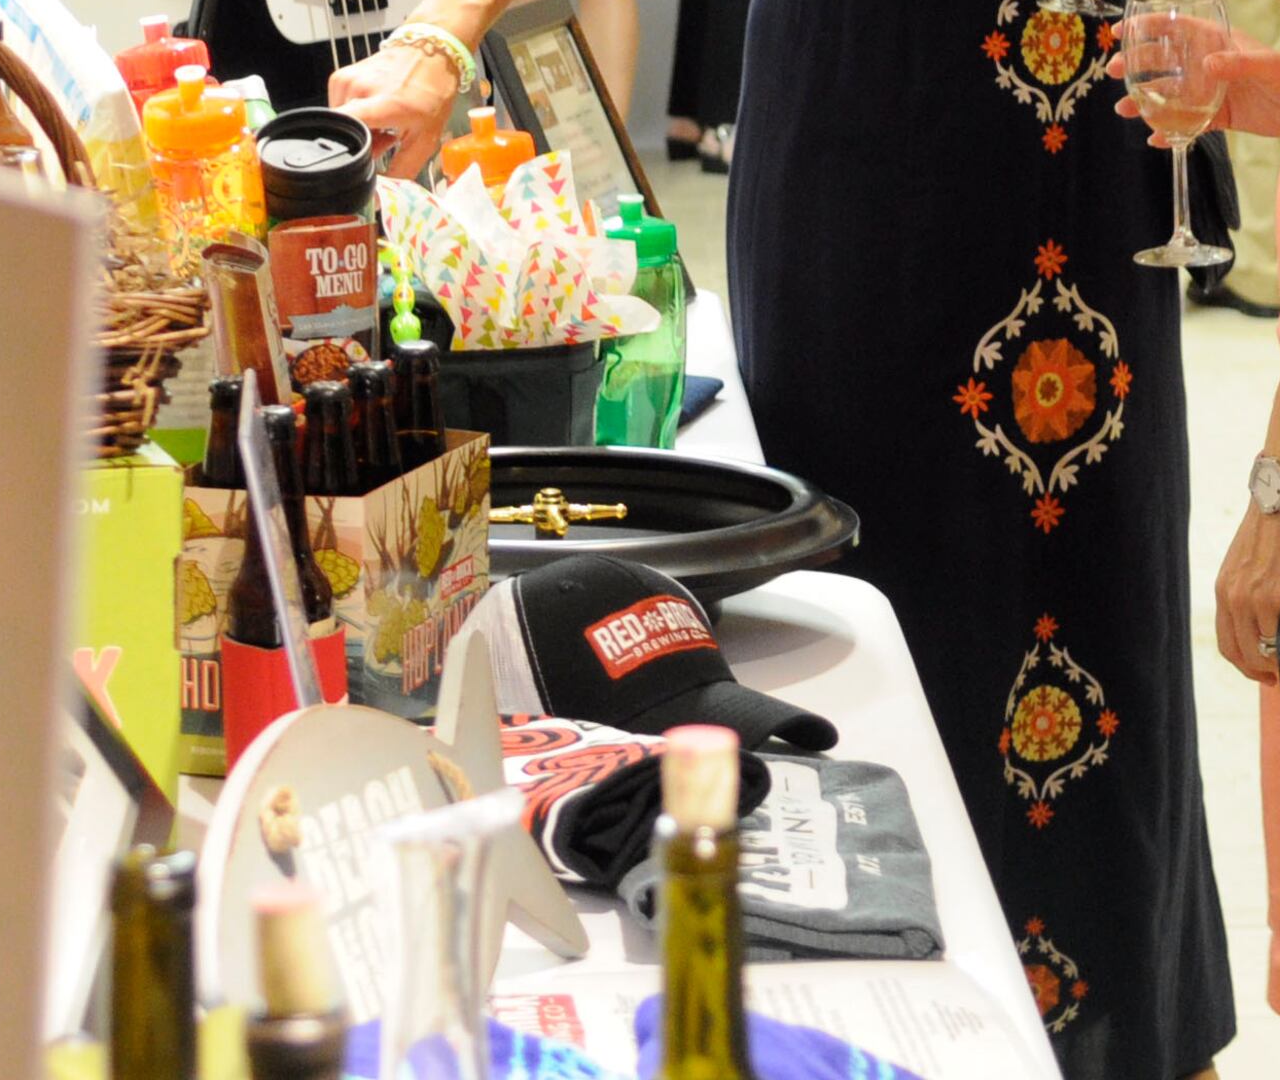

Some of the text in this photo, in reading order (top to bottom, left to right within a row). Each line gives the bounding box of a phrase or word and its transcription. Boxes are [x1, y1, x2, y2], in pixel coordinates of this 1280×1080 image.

[315, 271, 363, 298] MENU
[592, 612, 648, 661] RED
[632, 629, 690, 658] BREWING
